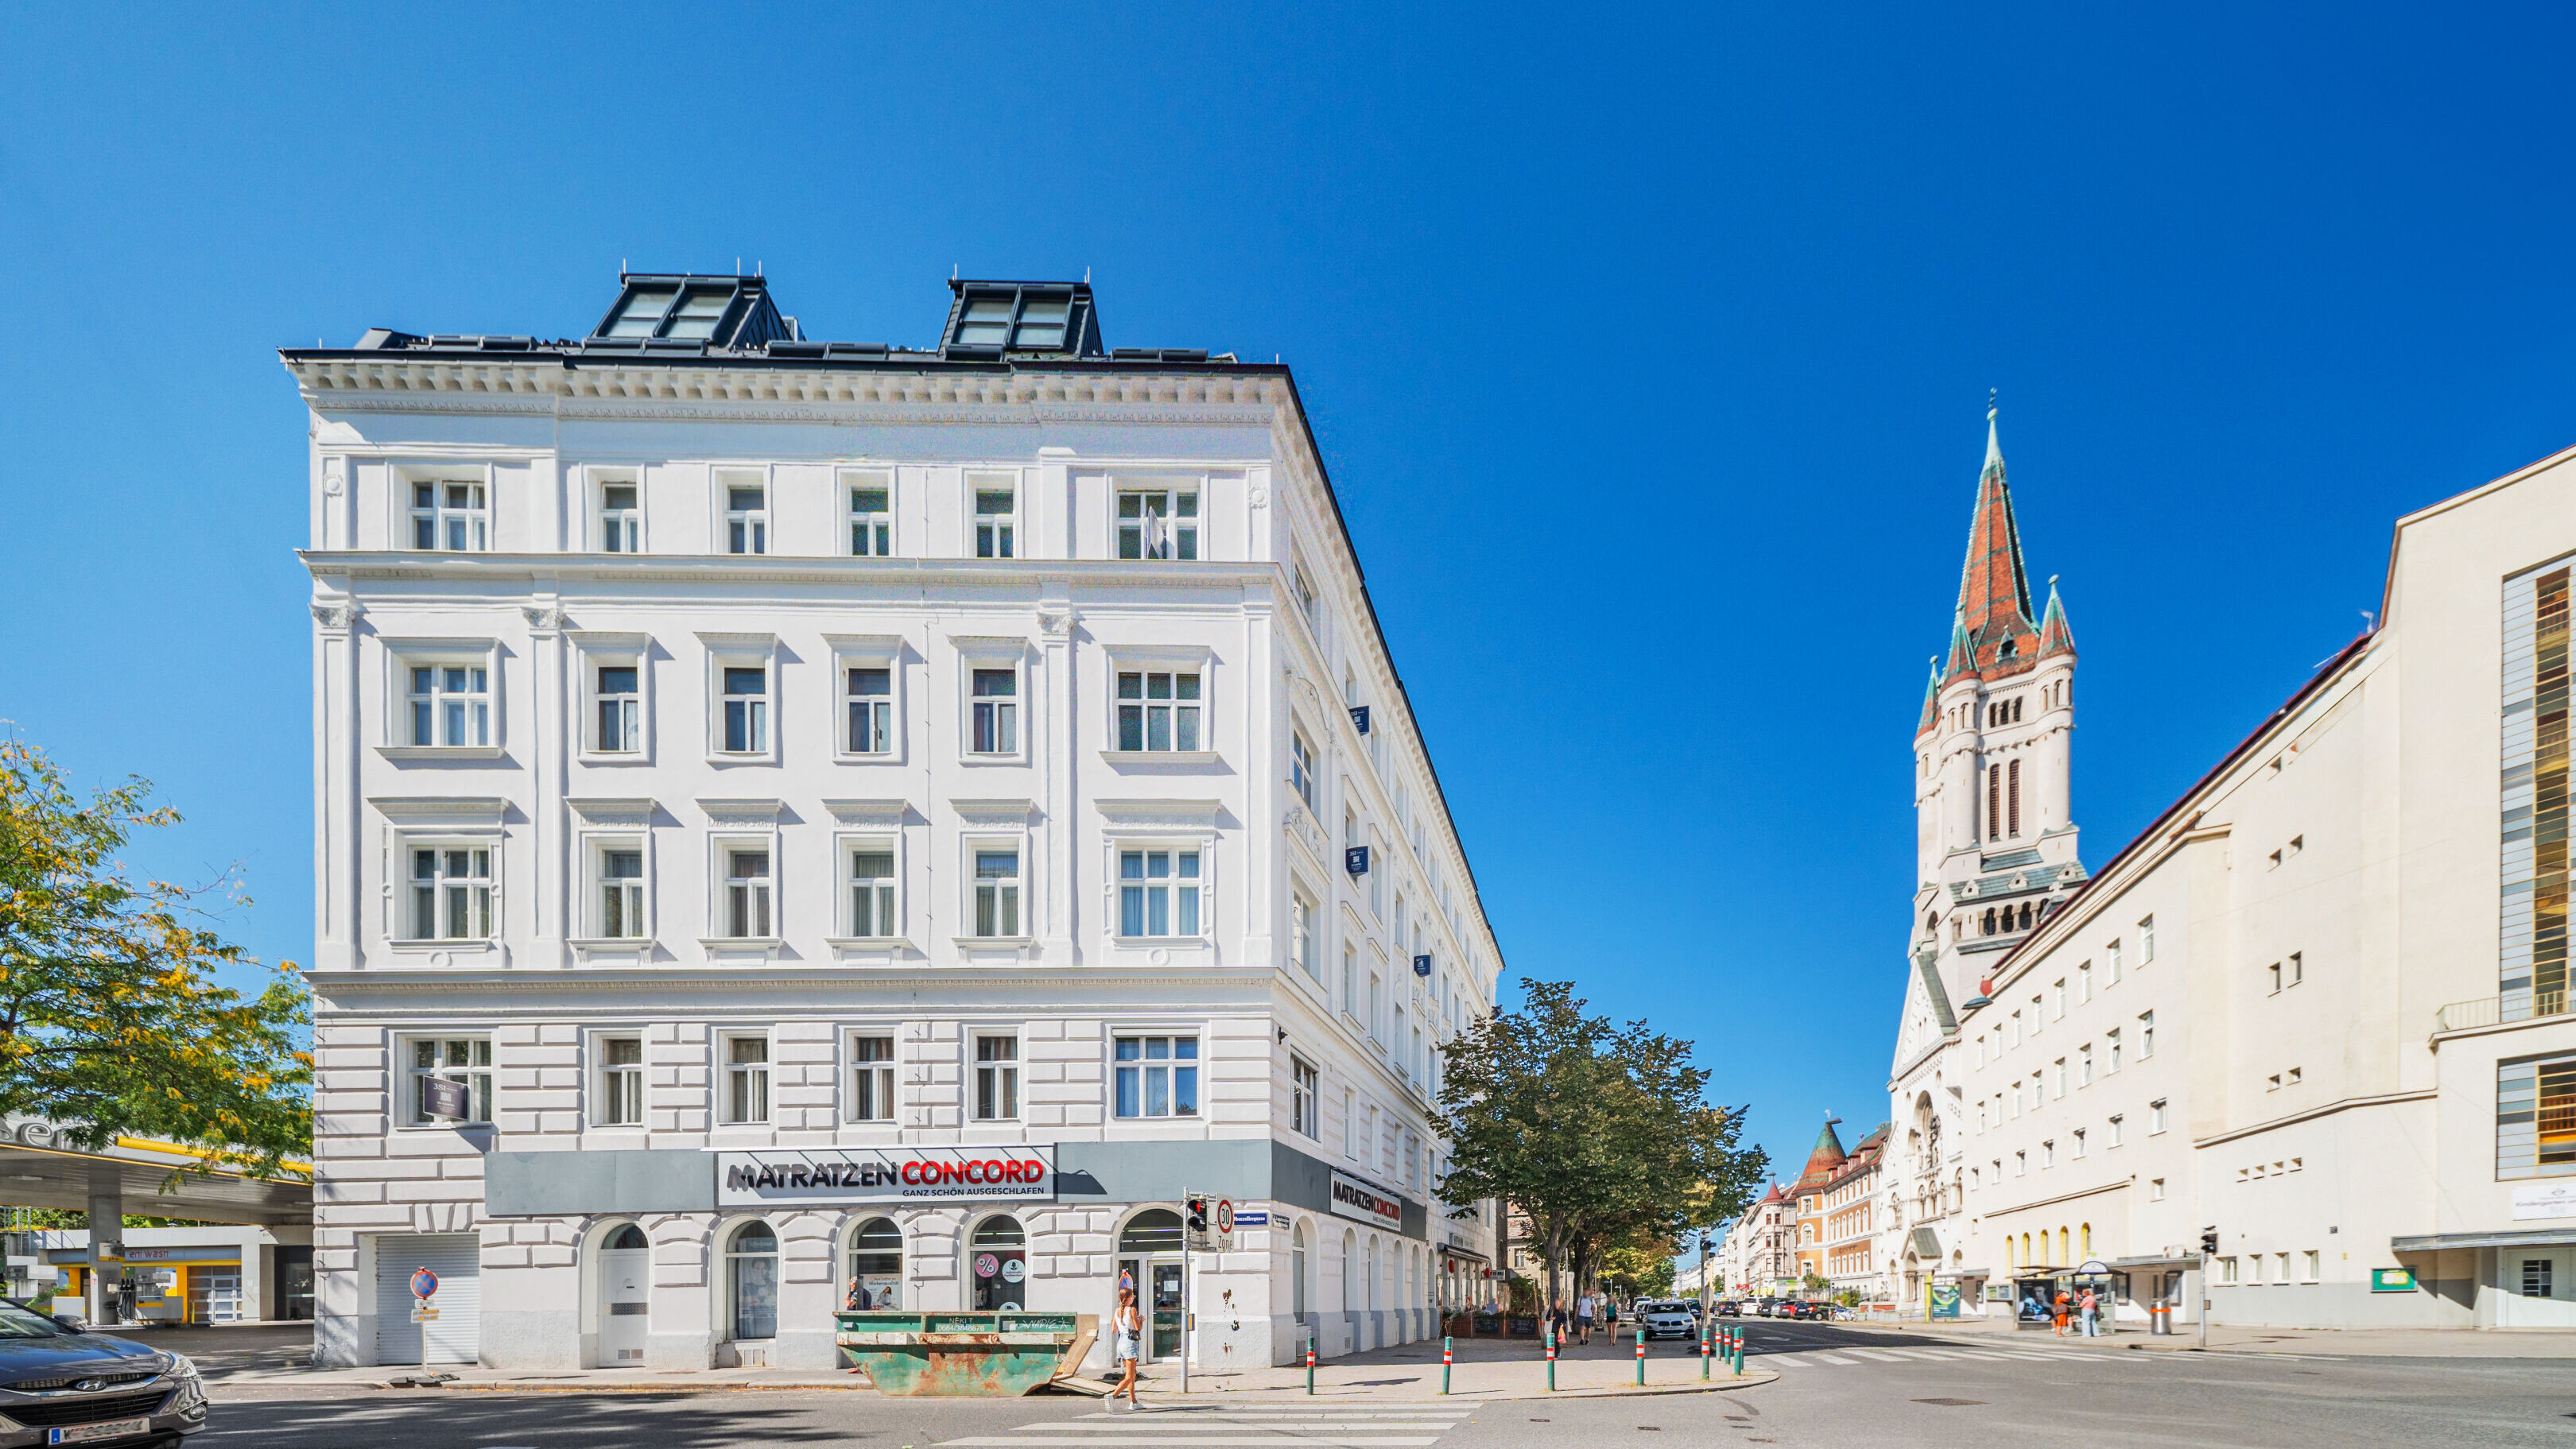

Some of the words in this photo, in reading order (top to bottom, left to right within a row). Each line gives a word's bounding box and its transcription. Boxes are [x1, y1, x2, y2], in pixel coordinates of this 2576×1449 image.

[727, 1161, 898, 1189] MATRATZEN
[902, 1160, 1044, 1185] CONCORD
[931, 1187, 964, 1196] SCHÖN
[966, 1187, 1045, 1195] AUSGESCHLAFEN
[1333, 1180, 1374, 1212] MATRATZEN
[1374, 1196, 1400, 1221] CONCORD
[1221, 1208, 1230, 1225] 30
[144, 1249, 169, 1258] wash
